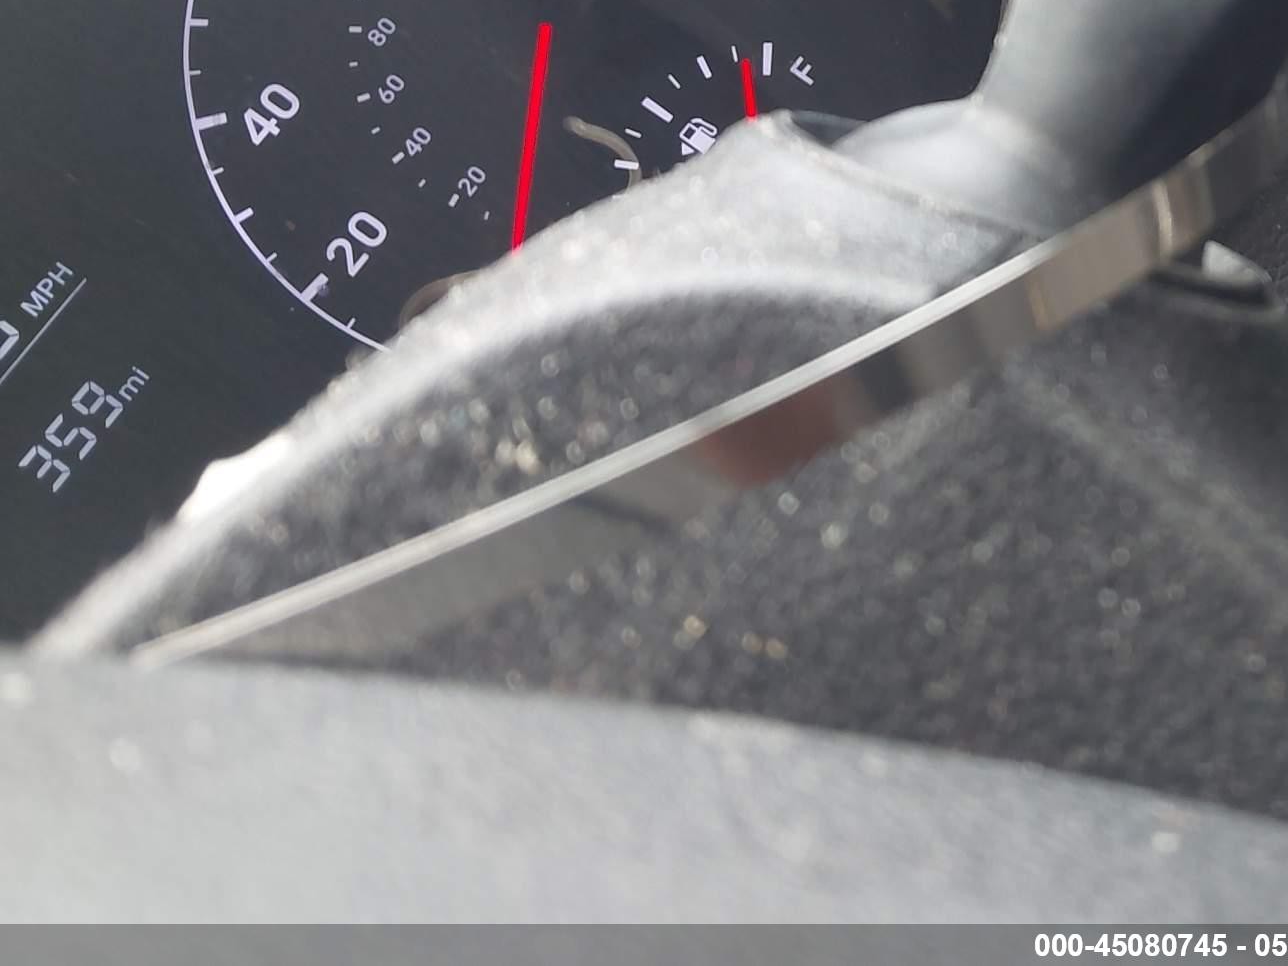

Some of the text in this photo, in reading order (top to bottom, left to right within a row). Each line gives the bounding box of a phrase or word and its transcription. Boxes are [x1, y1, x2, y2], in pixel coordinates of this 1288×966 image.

[367, 17, 396, 47] 80
[790, 56, 814, 86] F
[378, 73, 405, 104] 60
[243, 83, 300, 146] 40
[405, 126, 432, 157] 40
[457, 165, 486, 198] 20
[326, 211, 388, 278] 20
[20, 261, 73, 317] MPH
[18, 365, 150, 493] 359 mi
